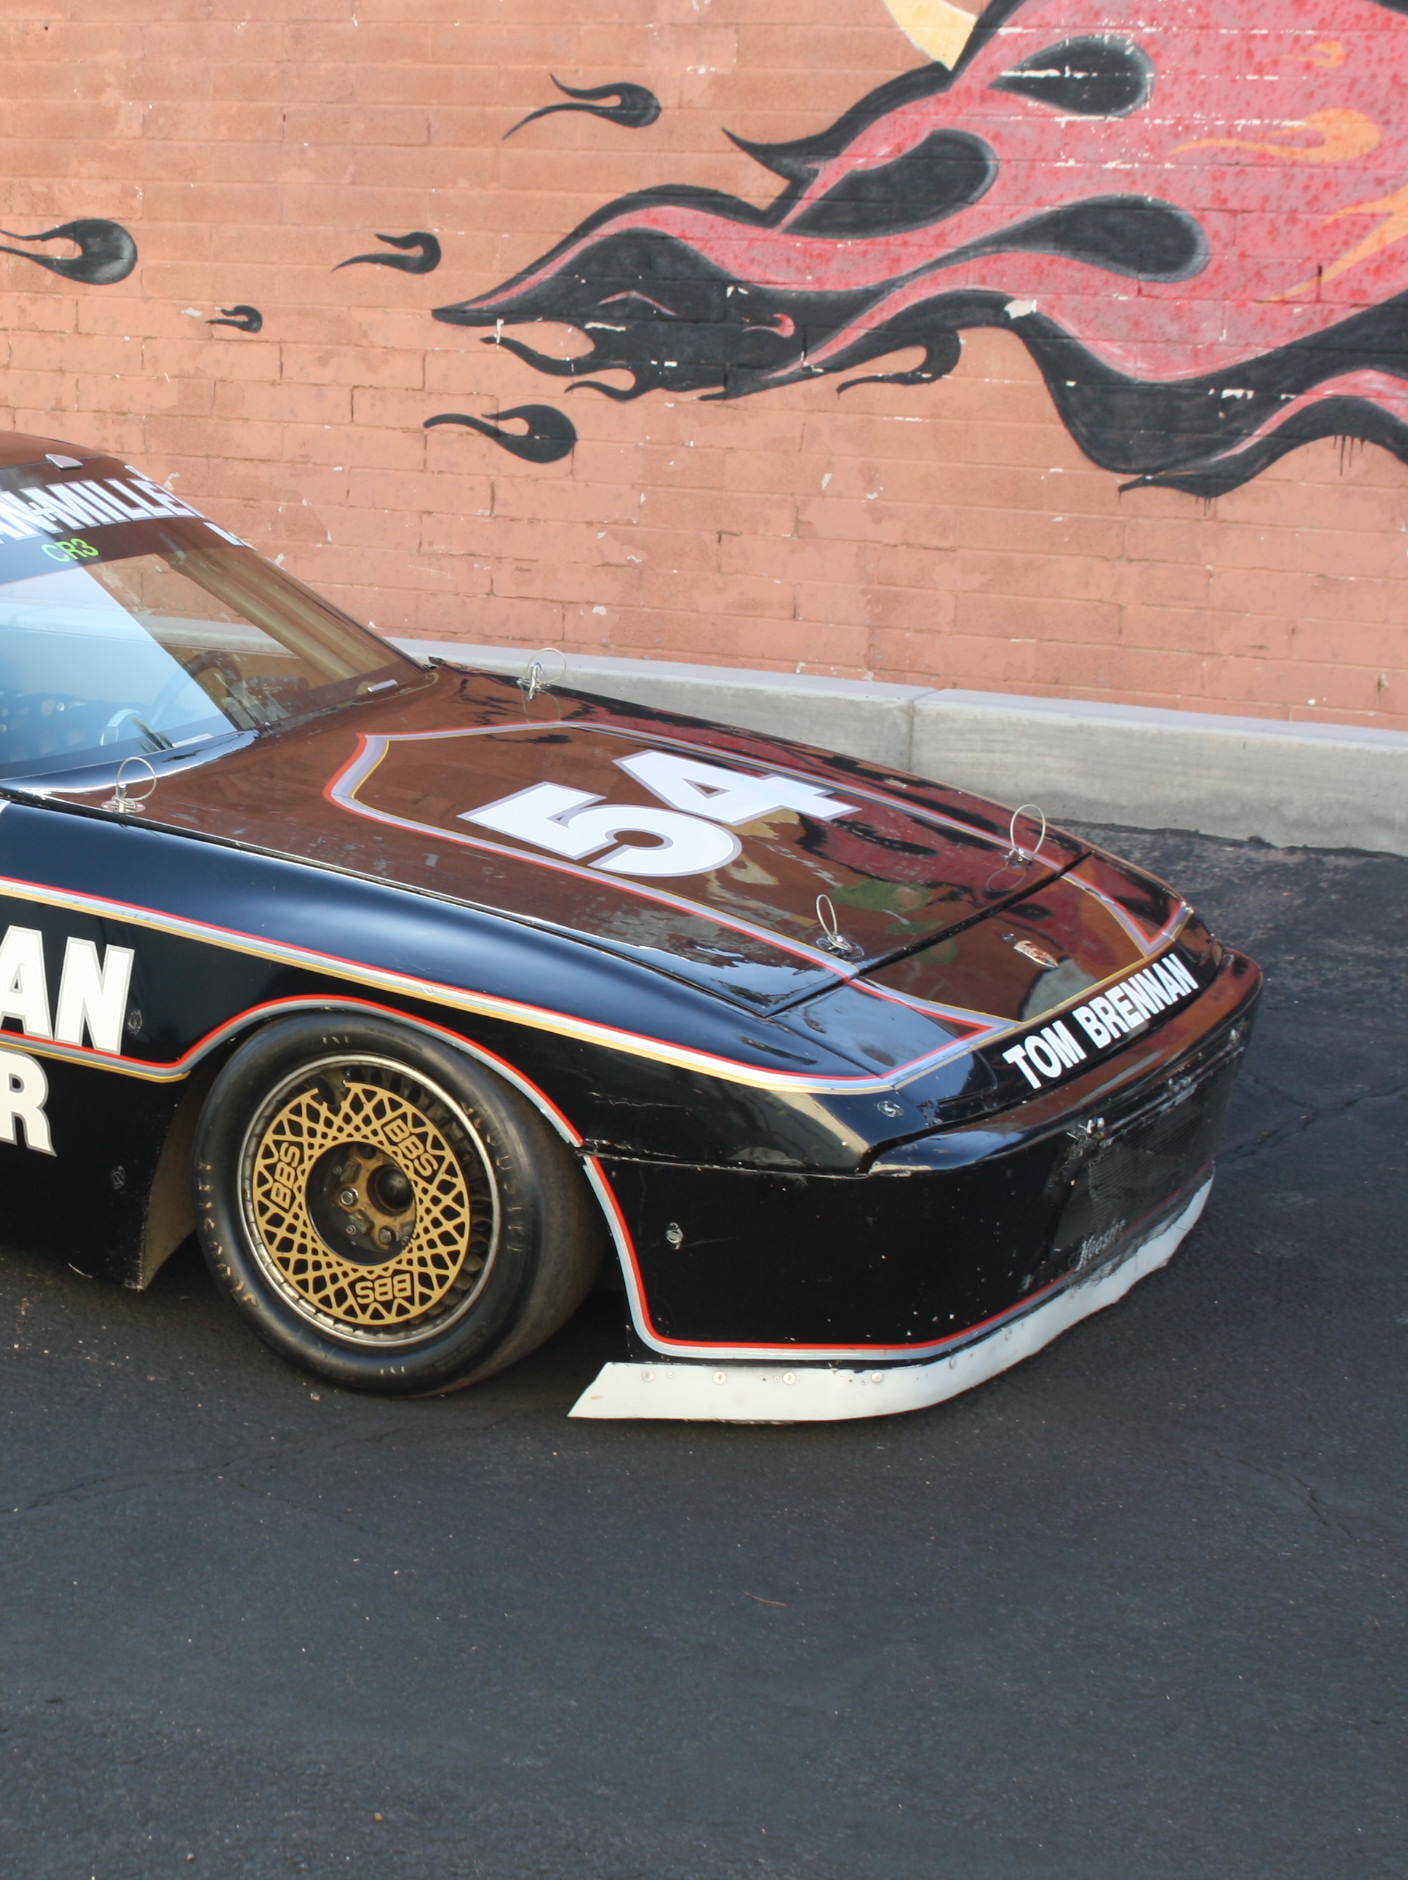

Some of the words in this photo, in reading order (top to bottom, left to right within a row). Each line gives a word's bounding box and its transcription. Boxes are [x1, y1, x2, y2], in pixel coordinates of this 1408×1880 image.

[41, 538, 99, 562] CR3
[457, 749, 863, 877] 54
[1002, 1019, 1087, 1089] TOM
[1071, 953, 1199, 1049] BRENNAN
[270, 1141, 302, 1211] BBS
[383, 1118, 438, 1177] BBS
[355, 1273, 413, 1304] BBS
